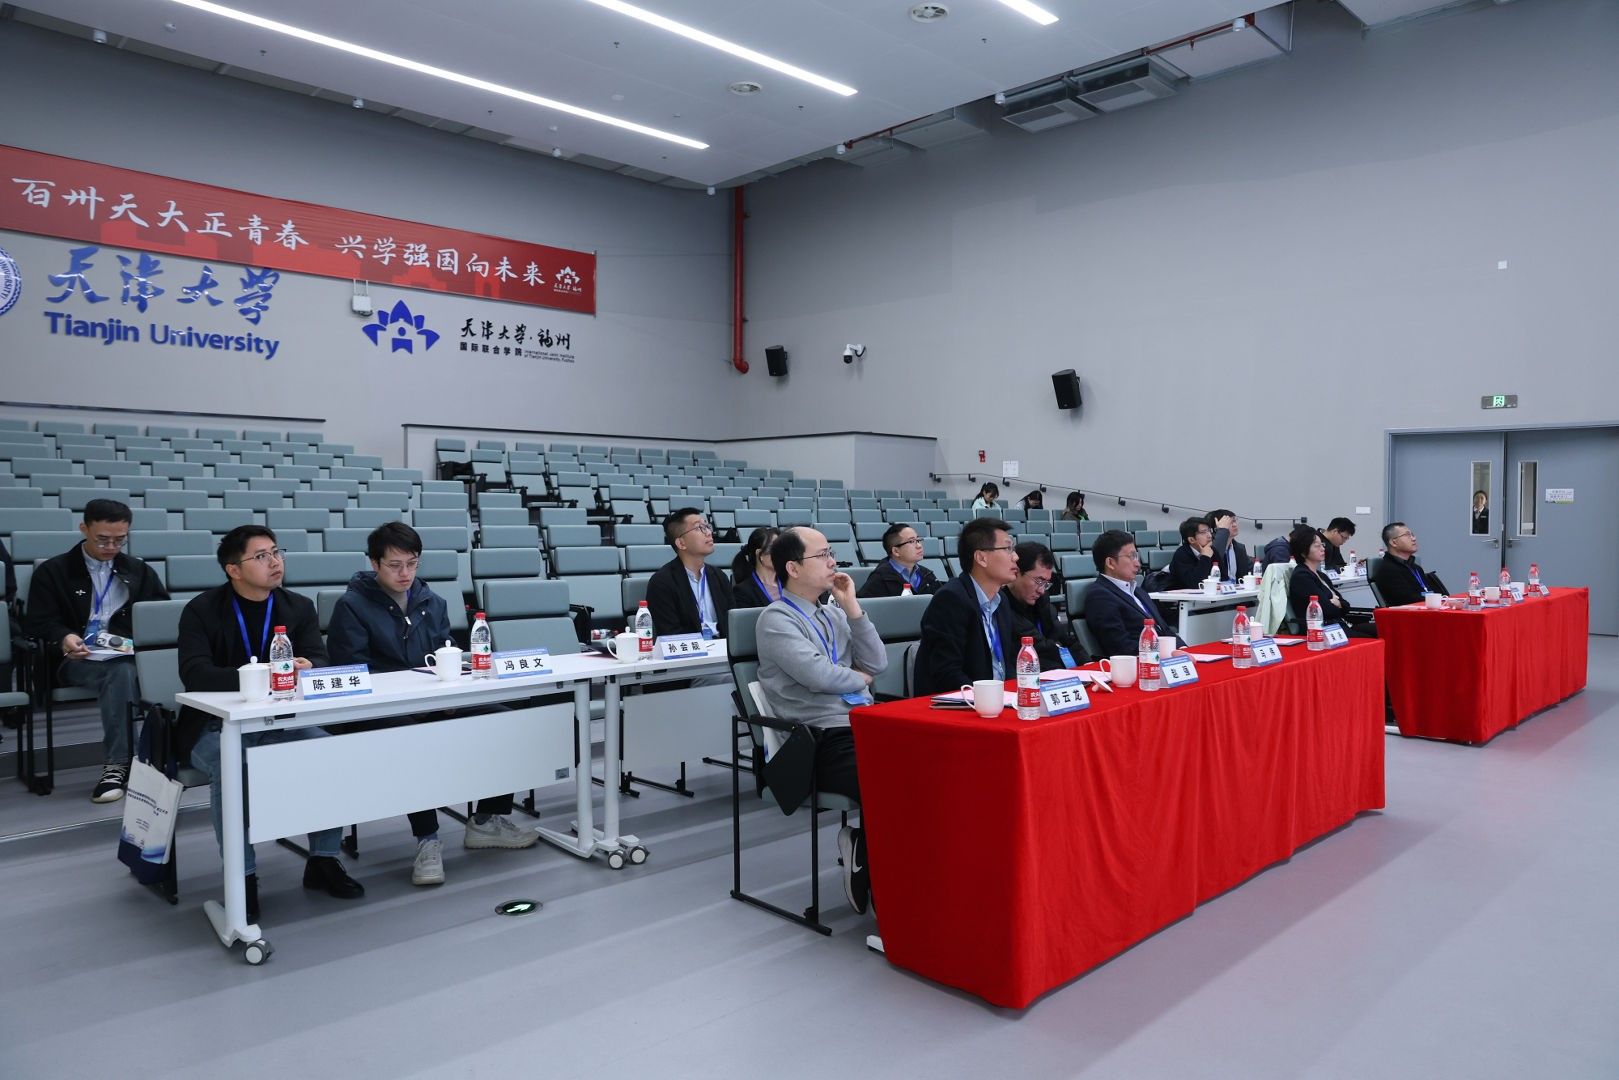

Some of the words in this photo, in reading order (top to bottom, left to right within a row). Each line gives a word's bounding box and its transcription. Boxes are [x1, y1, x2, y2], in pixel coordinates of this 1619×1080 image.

[335, 235, 545, 287] 兴学强国向未来
[46, 246, 281, 325] 天津大学
[44, 311, 140, 345] Tianjin
[150, 323, 280, 360] University
[460, 342, 522, 356] 国际联合学院
[504, 657, 544, 671] 冯良文
[312, 675, 361, 691] 陈建华
